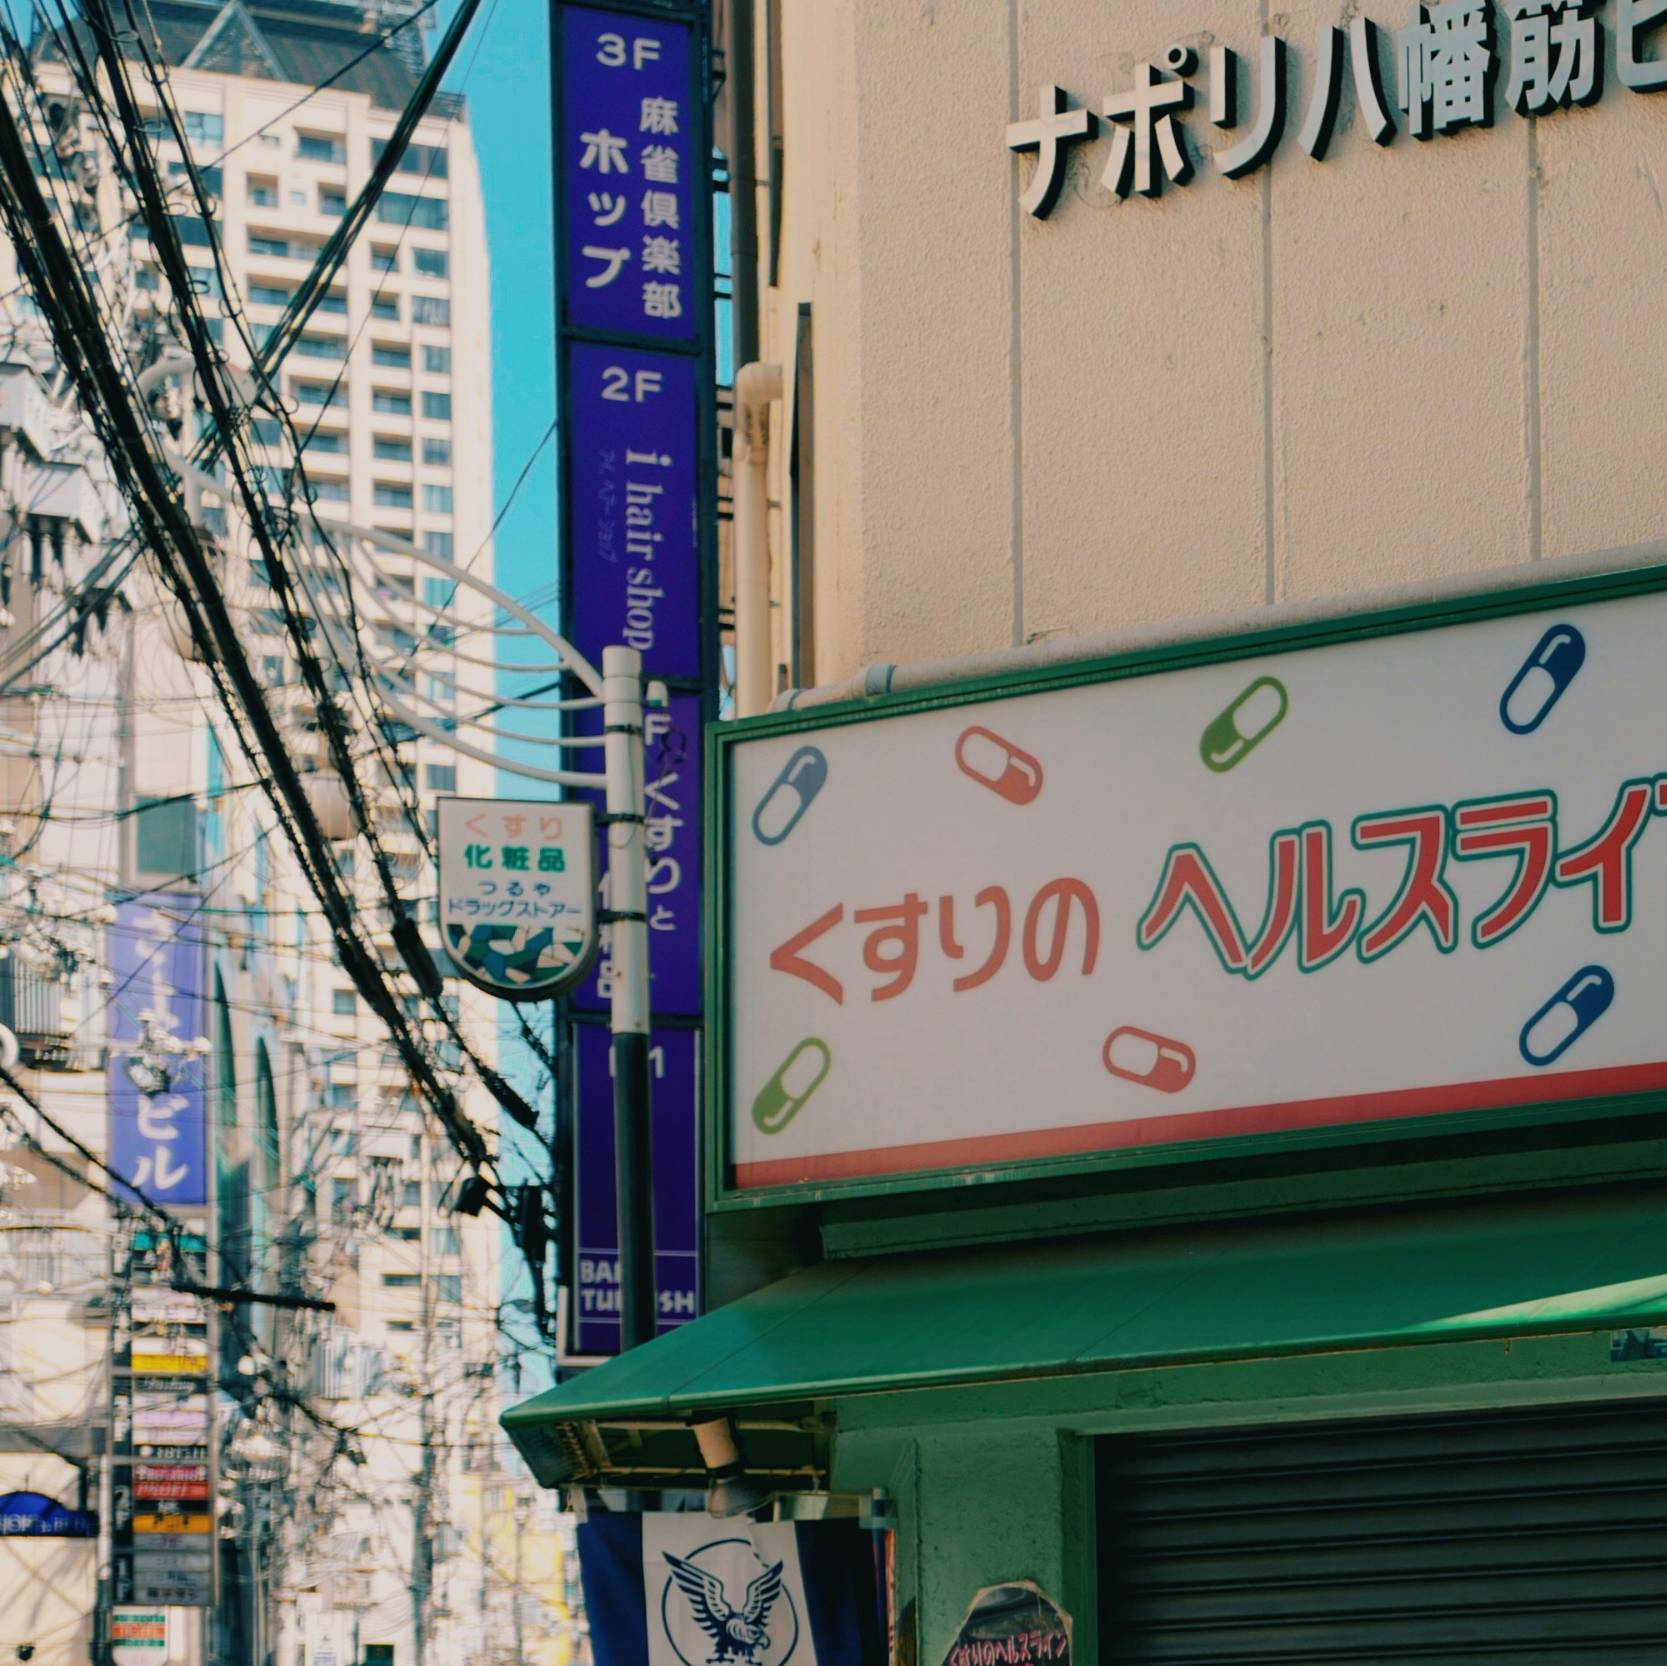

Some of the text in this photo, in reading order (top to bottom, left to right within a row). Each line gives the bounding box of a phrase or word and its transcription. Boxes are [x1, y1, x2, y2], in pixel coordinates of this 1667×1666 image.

[596, 33, 661, 70] 3F
[578, 128, 631, 288] ホップ
[639, 96, 682, 319] 麻雀倶楽部
[601, 366, 663, 402] 2F
[622, 448, 672, 650] i hair shop
[465, 813, 564, 840] くすり
[464, 843, 565, 873] 化粧品
[479, 880, 551, 897] つるや
[769, 877, 1100, 1006] くすりの
